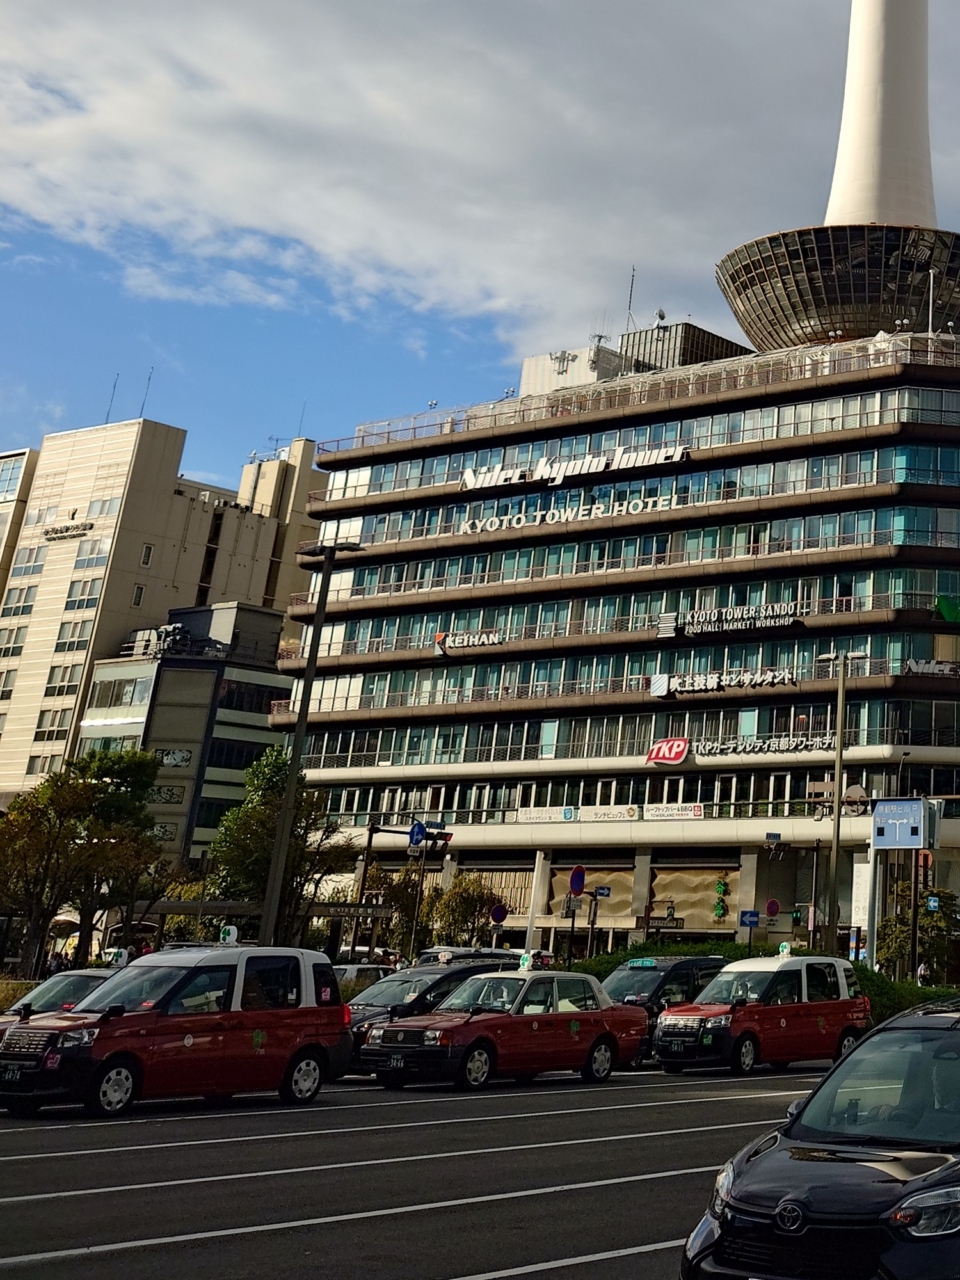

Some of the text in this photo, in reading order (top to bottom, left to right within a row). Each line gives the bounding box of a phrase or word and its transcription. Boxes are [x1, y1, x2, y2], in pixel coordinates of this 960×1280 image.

[458, 445, 690, 491] Nidec Kyoto Tower
[459, 494, 684, 534] KYOTO TOWER HOTEL
[685, 603, 795, 623] KYOTO TOWER SANDO
[685, 624, 701, 633] FOOD
[723, 621, 750, 631] MARKET
[755, 618, 794, 628] WORKSHOP
[445, 633, 499, 648] KEIHAN
[905, 658, 956, 675] Nidec
[651, 740, 681, 759] TKP
